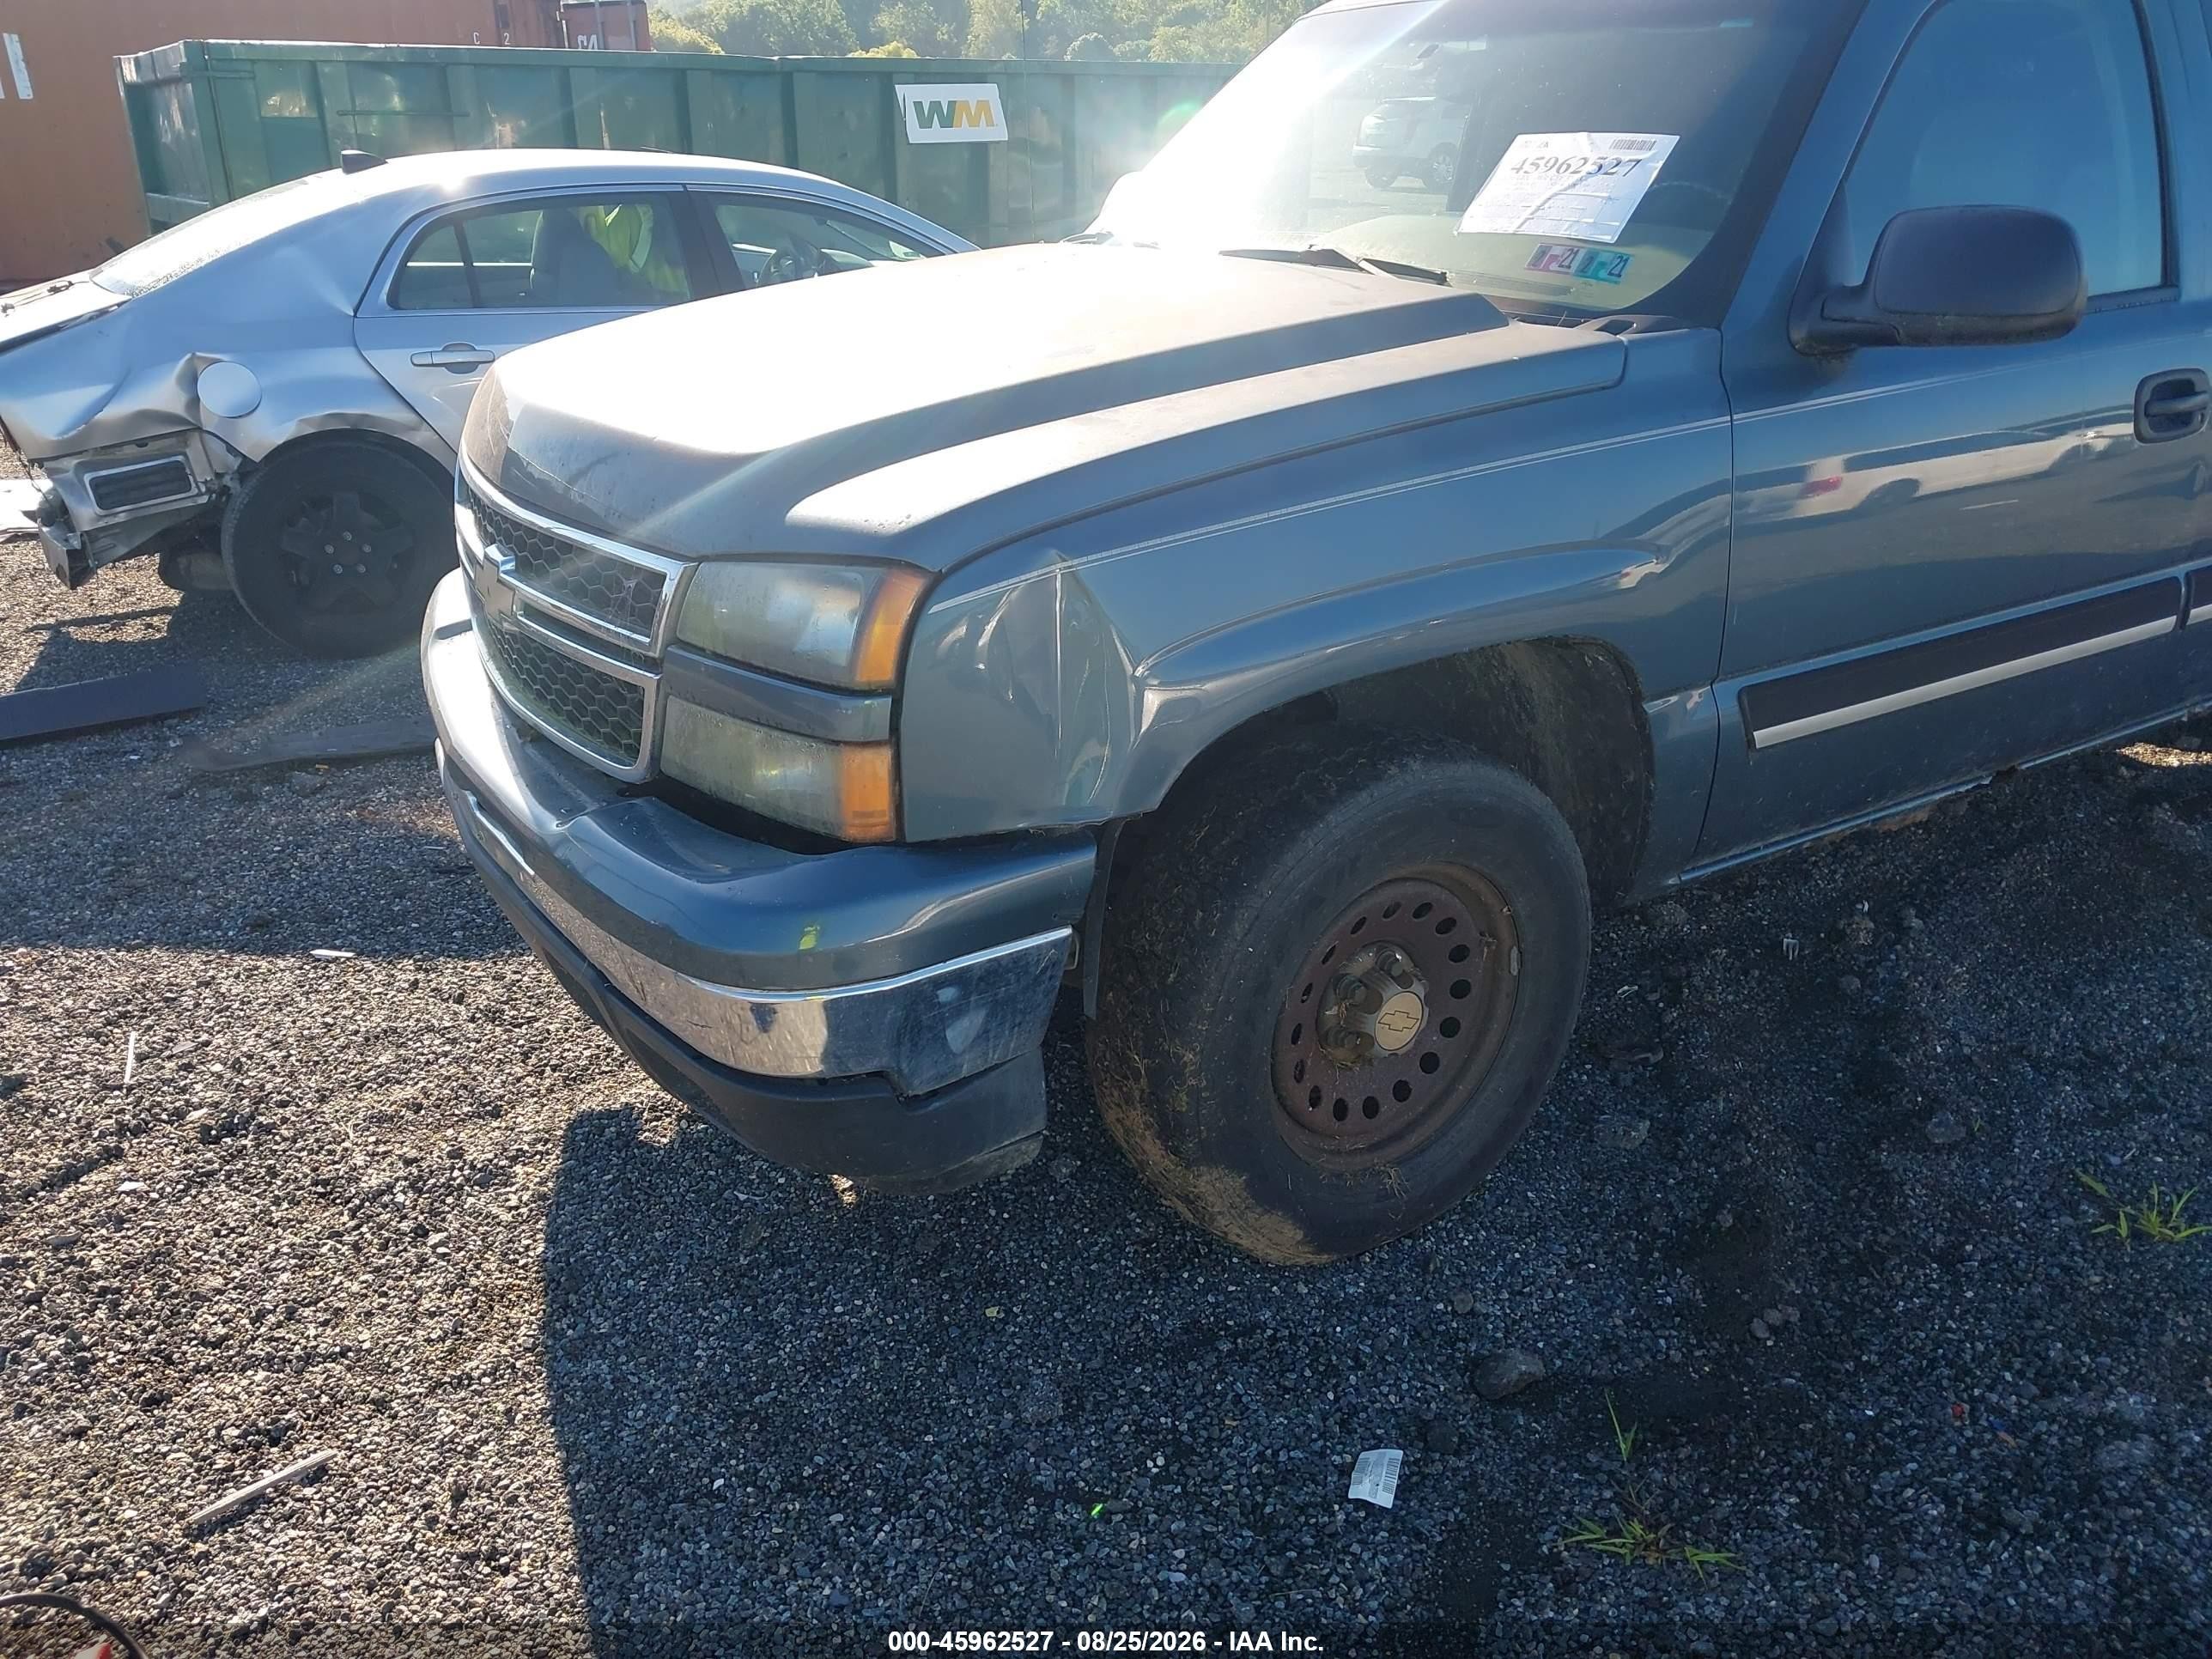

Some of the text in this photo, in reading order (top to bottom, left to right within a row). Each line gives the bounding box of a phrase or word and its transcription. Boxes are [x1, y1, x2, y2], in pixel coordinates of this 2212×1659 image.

[473, 32, 511, 46] C 2
[913, 100, 994, 129] WM
[1510, 155, 1643, 178] 45962527
[1559, 247, 1581, 269] 21
[1607, 253, 1631, 277] 21
